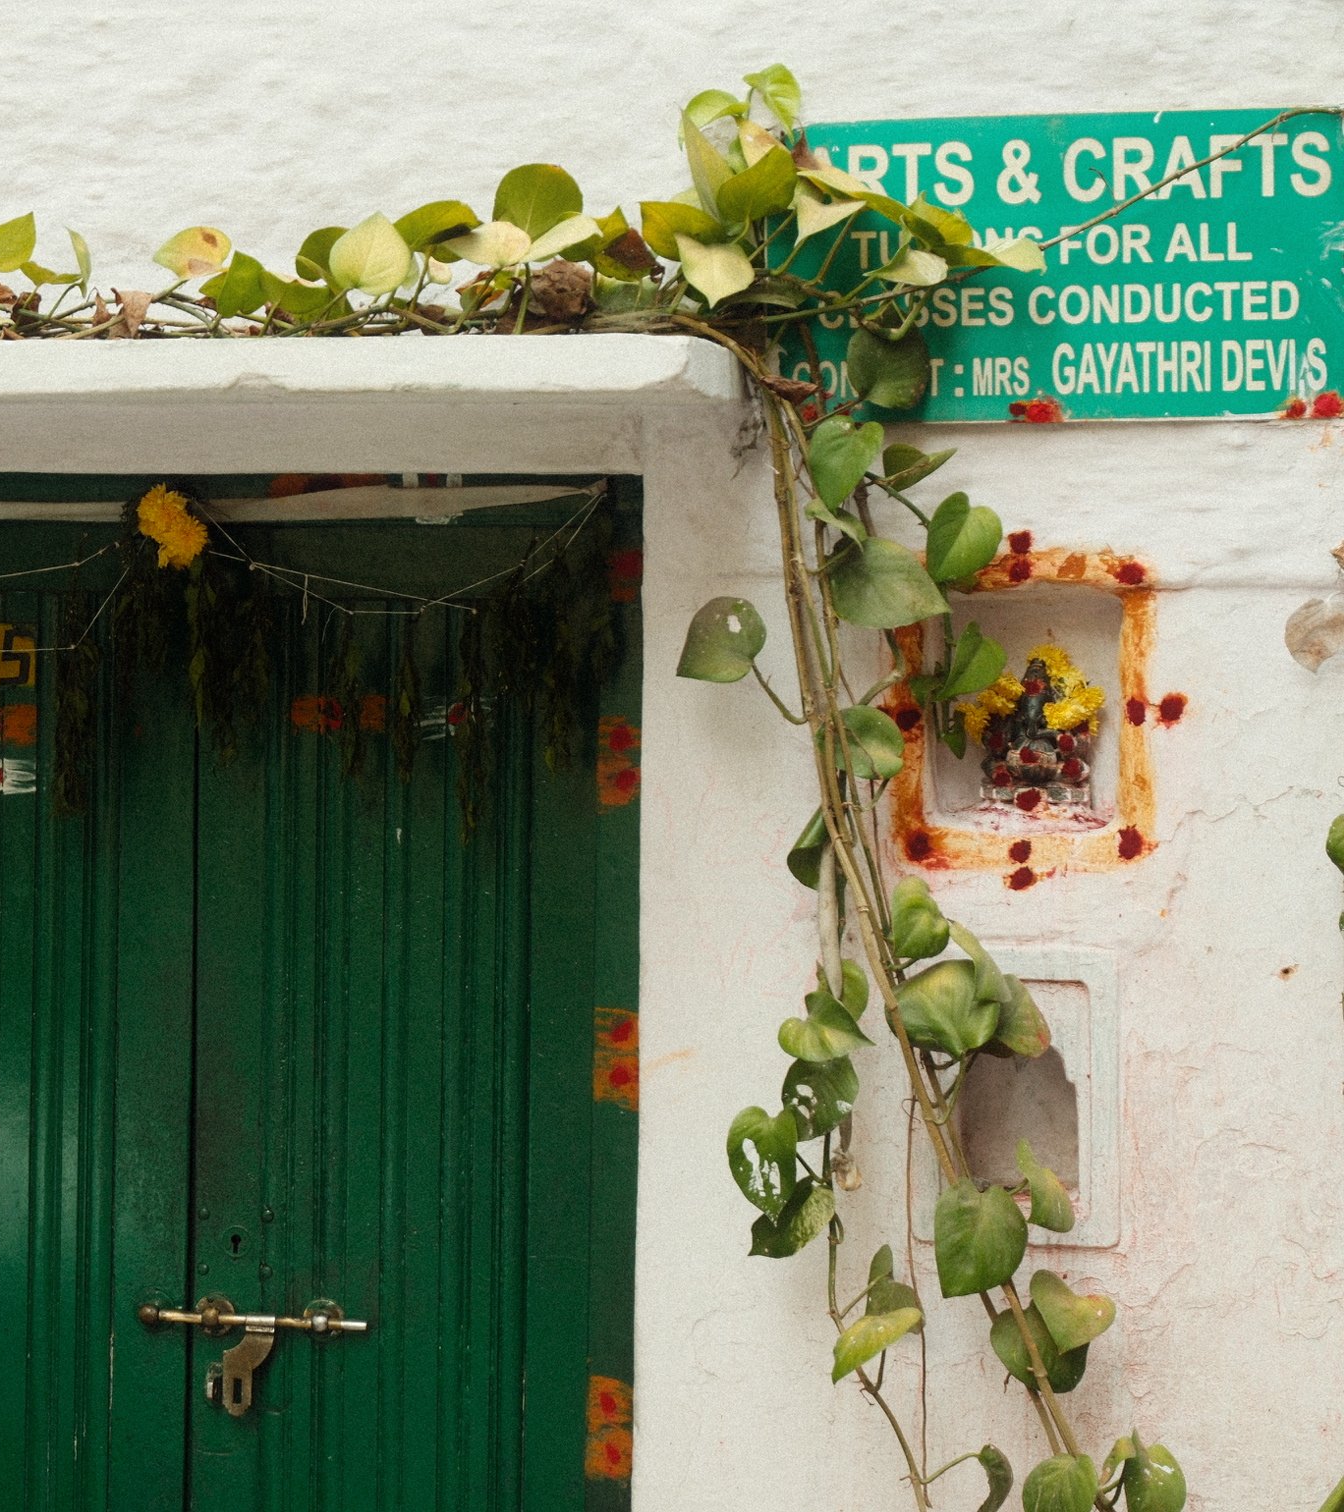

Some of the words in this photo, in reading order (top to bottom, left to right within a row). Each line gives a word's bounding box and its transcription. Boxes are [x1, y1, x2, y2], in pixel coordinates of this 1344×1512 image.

[996, 139, 1042, 205] &
[1063, 131, 1332, 203] CRAFTS
[1058, 223, 1153, 265] FOR
[1164, 222, 1253, 263] ALL
[1028, 280, 1300, 326] CONDUCTED
[972, 356, 1030, 396] MRS
[1051, 341, 1211, 395] GAYATHRI
